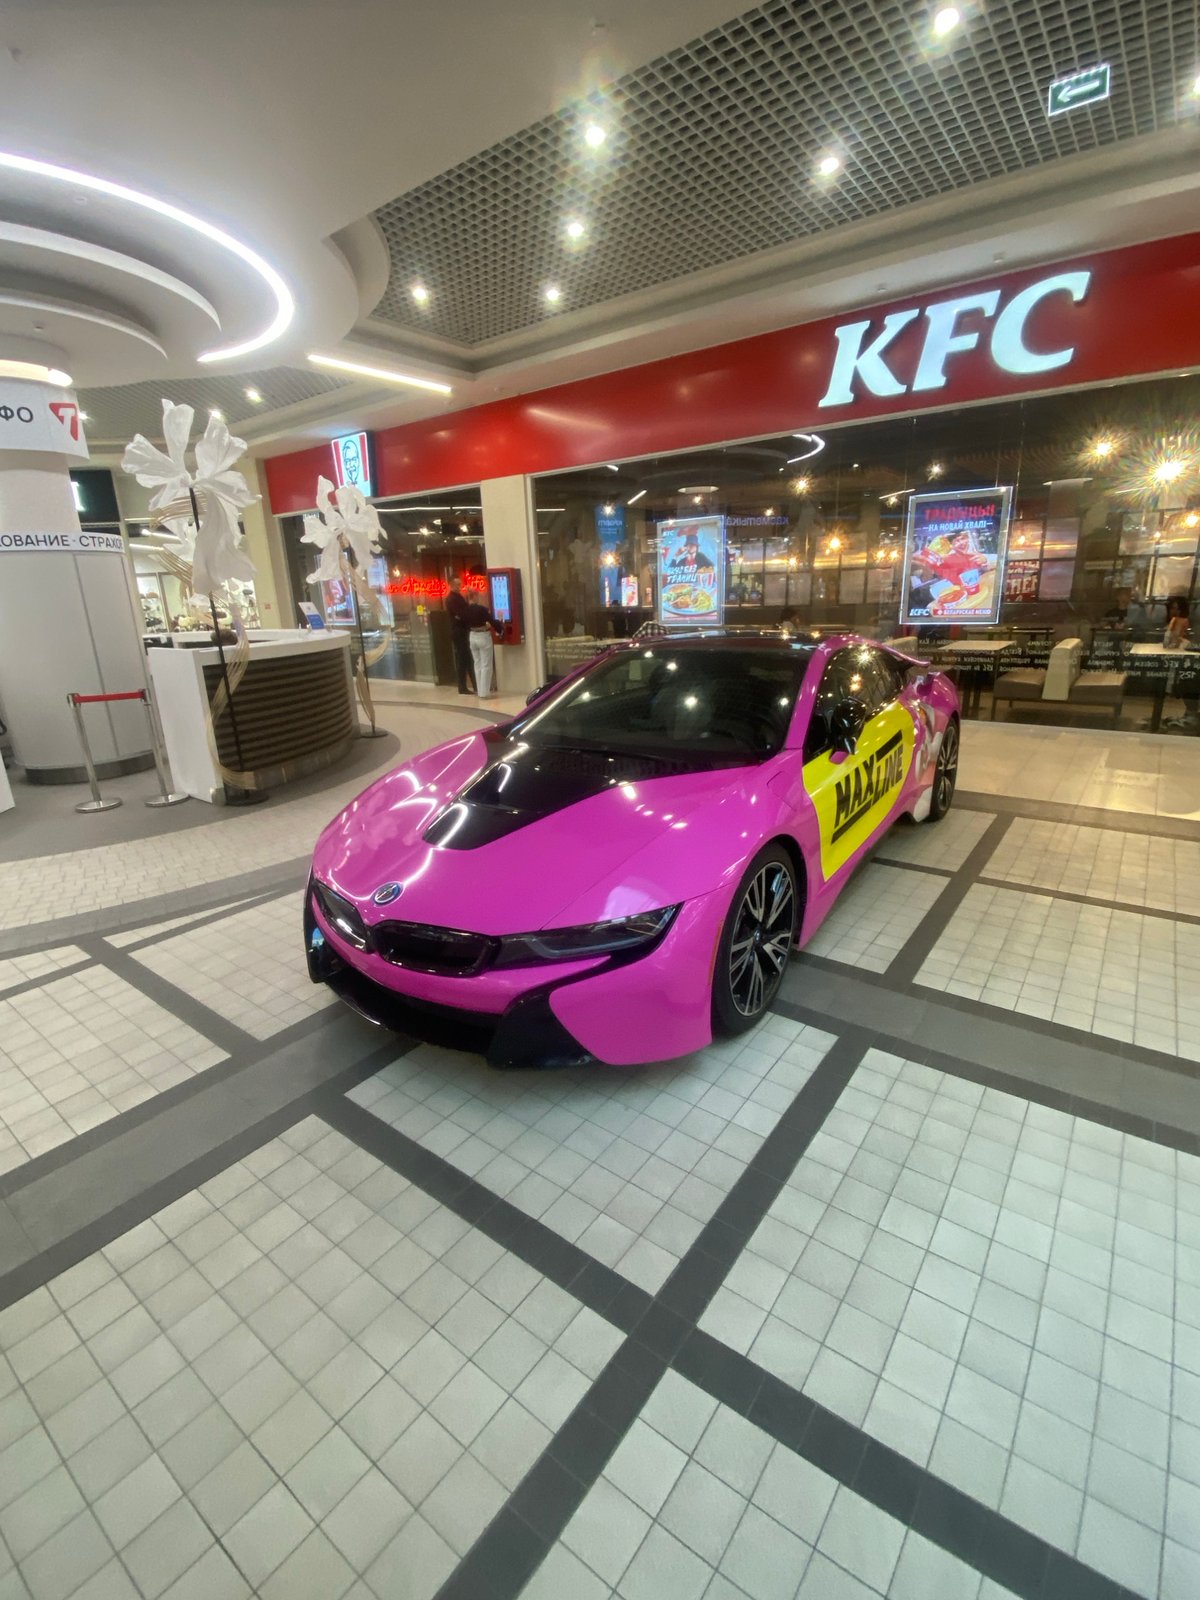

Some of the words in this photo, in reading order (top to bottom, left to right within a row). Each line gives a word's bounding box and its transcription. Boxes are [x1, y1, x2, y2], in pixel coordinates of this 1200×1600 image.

[818, 271, 1091, 408] KFC
[928, 523, 939, 532] НА
[0, 534, 69, 547] ОВАНИЕ
[909, 608, 930, 616] KFC
[834, 743, 904, 829] MAXLINE
